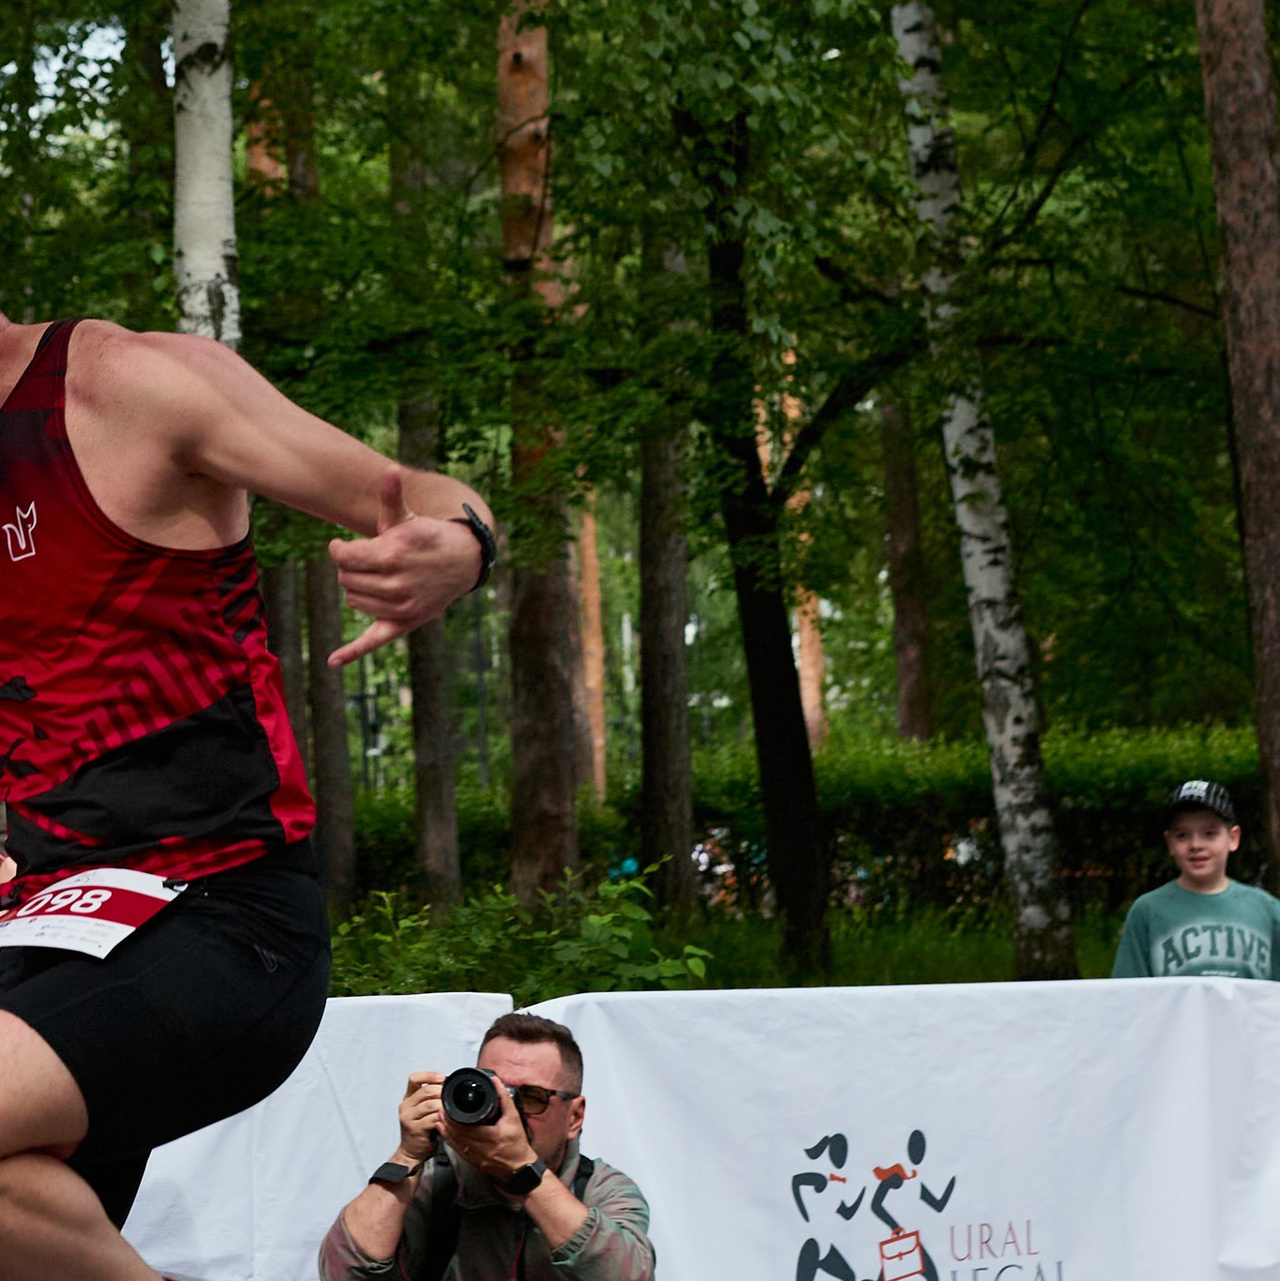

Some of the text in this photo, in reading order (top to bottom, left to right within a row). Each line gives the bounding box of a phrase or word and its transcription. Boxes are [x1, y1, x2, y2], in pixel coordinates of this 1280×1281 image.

[16, 888, 113, 918] 098
[1161, 924, 1270, 976] ACTIVE
[949, 1219, 1040, 1262] URAL
